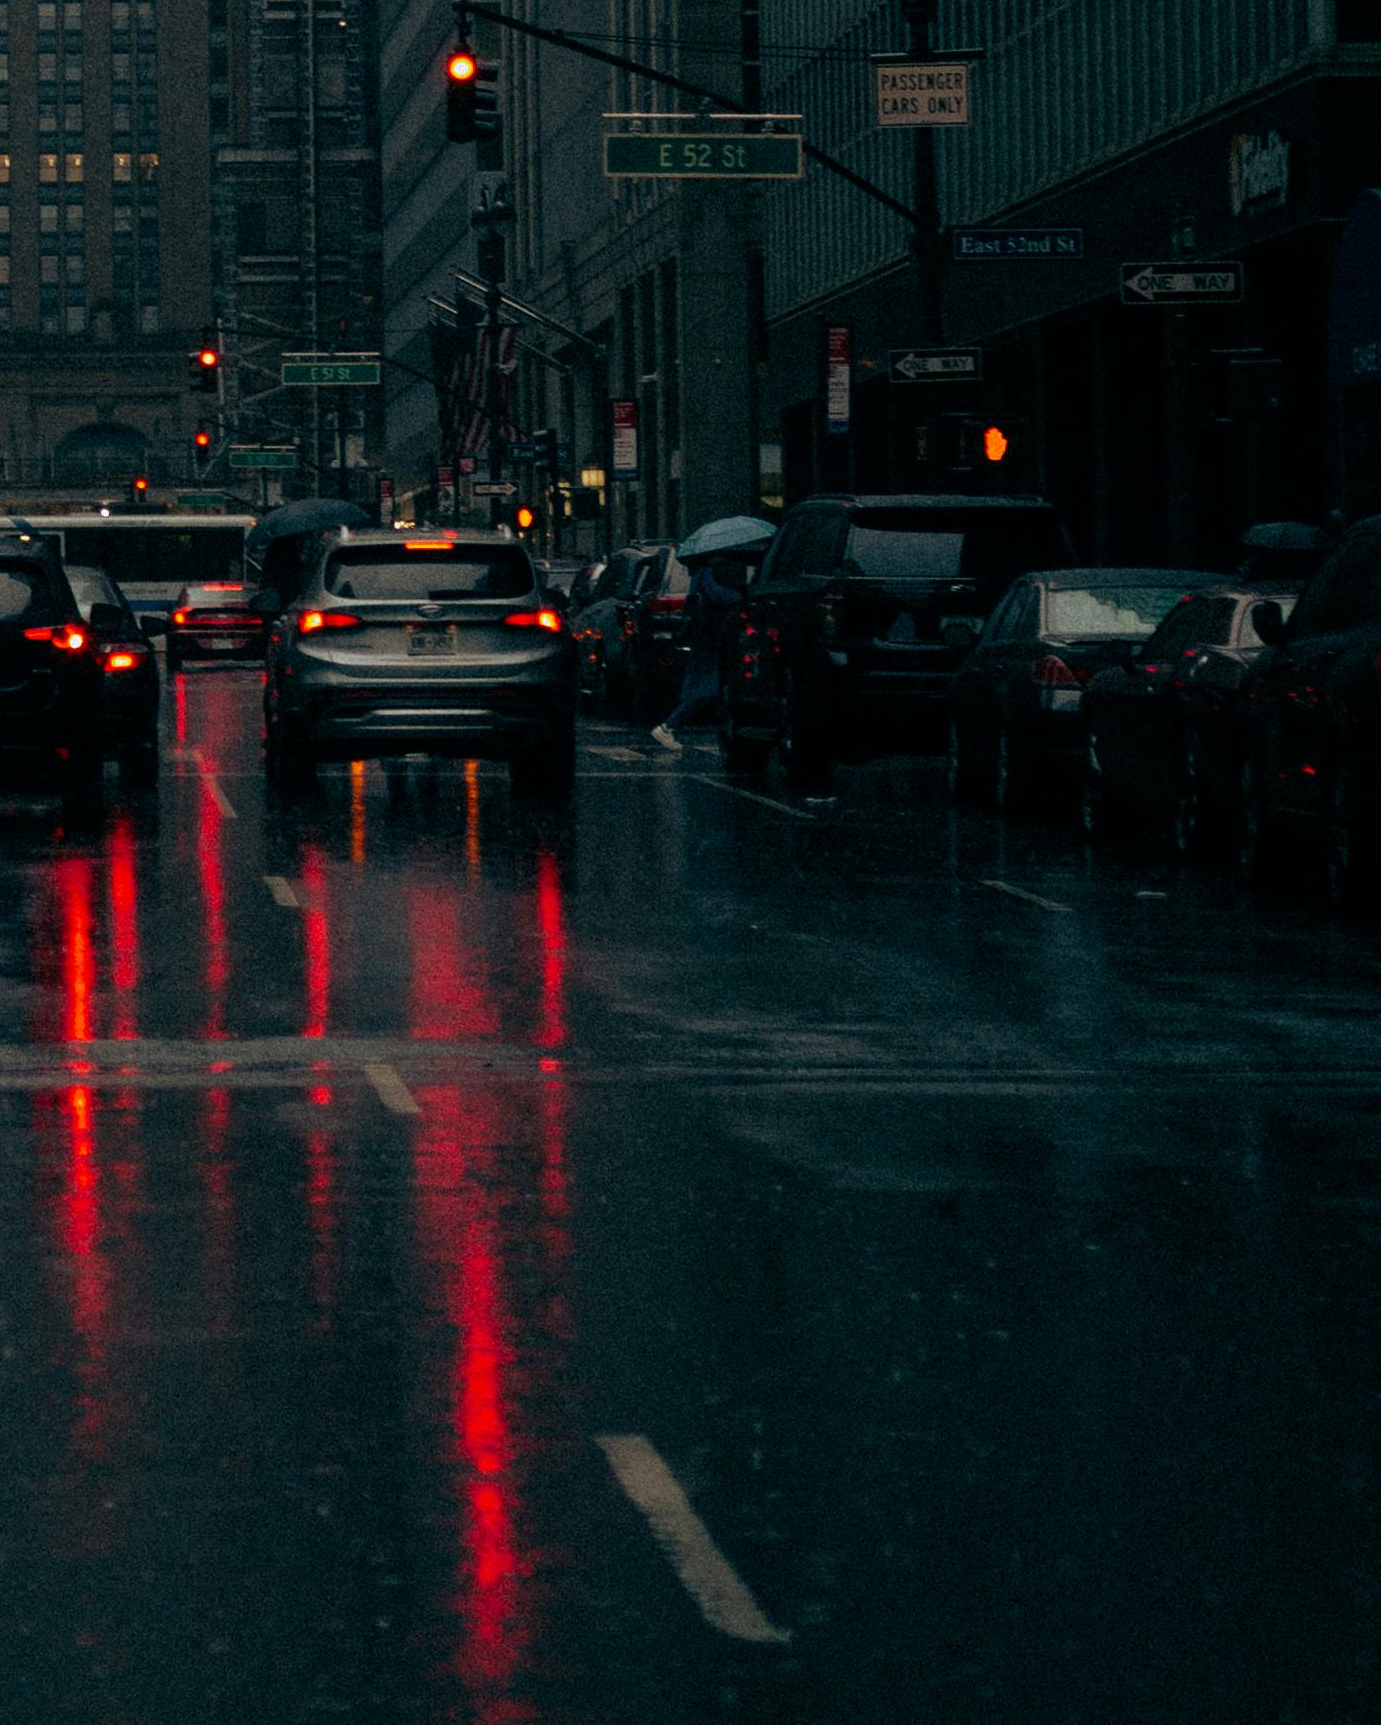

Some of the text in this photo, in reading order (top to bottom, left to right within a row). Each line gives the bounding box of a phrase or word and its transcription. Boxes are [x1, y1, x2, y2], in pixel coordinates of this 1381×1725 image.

[881, 74, 963, 91] PASSENGER
[882, 96, 963, 115] CARS ONLY
[659, 143, 747, 168] E 52 St
[959, 235, 1076, 254] East 52nd St
[1138, 274, 1230, 291] ONE WAY
[903, 357, 968, 372] ONE WAY
[310, 367, 319, 381] E
[338, 367, 351, 381] St
